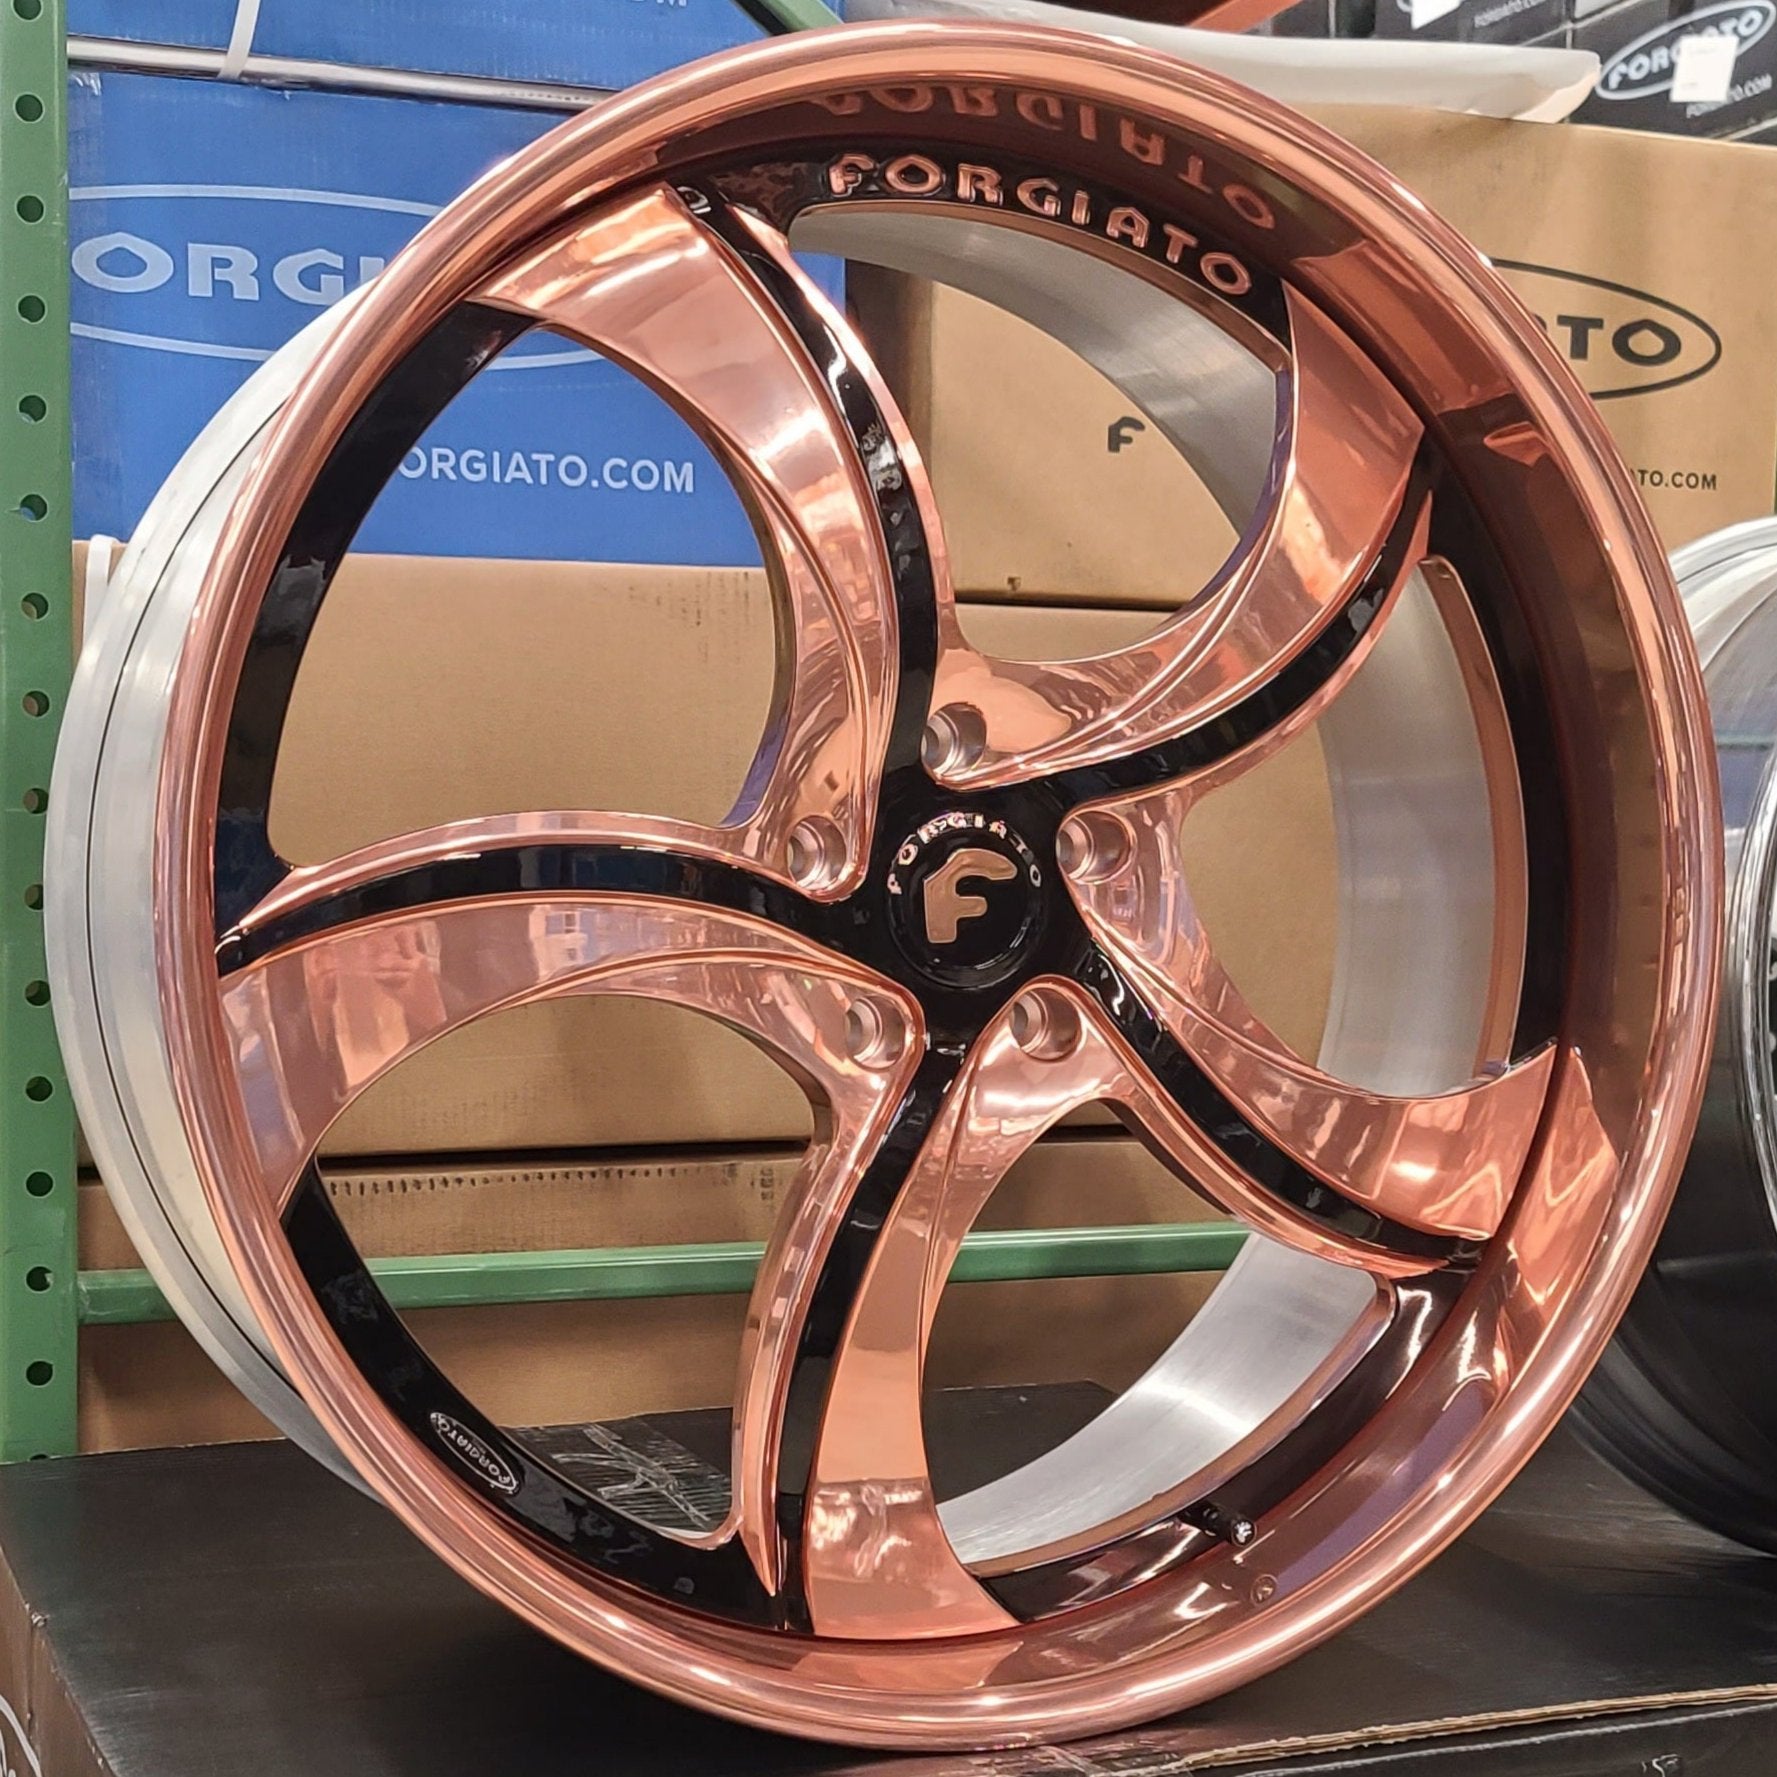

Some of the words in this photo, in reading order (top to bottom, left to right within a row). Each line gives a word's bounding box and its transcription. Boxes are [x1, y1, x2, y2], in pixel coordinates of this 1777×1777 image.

[1607, 8, 1764, 90] FORTO
[826, 152, 1253, 296] FORGIATO
[71, 231, 386, 306] ORGI
[1532, 312, 1682, 367] TO
[399, 447, 695, 493] ORGIATO.COM
[1107, 416, 1146, 454] F
[1630, 468, 1718, 491] TO.COM
[887, 810, 1042, 895] FORGIATO
[924, 848, 1018, 944] F
[438, 1417, 512, 1484] FORGIATO
